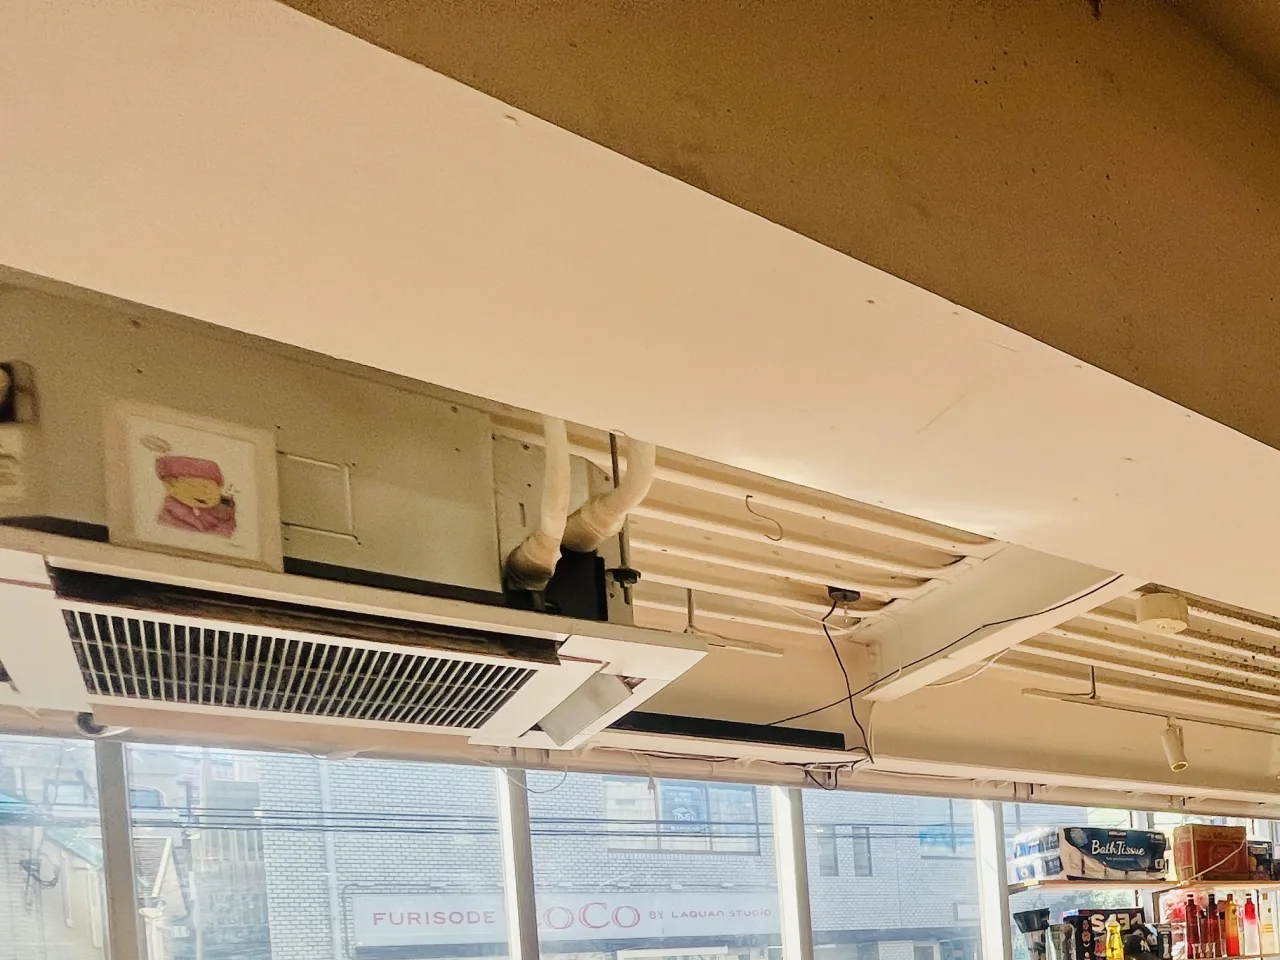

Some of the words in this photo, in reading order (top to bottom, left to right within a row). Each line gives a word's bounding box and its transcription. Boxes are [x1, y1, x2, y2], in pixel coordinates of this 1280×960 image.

[1091, 839, 1116, 855] Bath
[1115, 841, 1145, 856] Tissue
[372, 911, 495, 926] FURISODE
[537, 902, 641, 930] OCO
[649, 911, 664, 920] BY
